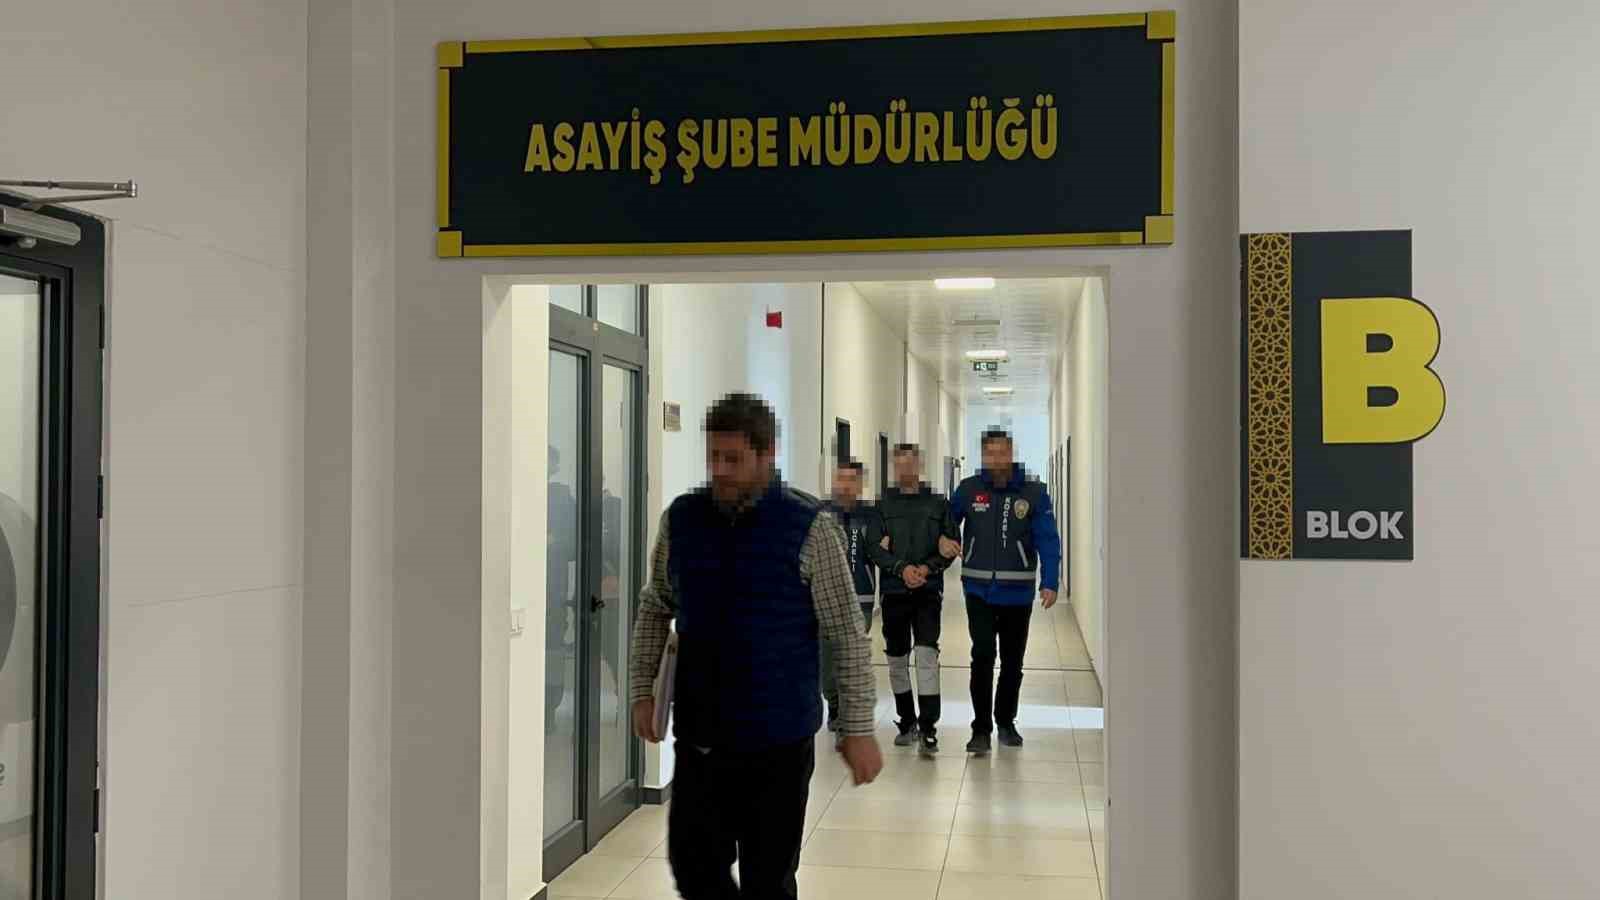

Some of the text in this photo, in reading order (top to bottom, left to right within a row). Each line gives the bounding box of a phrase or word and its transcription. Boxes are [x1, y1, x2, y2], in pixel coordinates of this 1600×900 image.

[524, 94, 1057, 184] ASAYİŞ ŞUBE MÜDÜRLÜĞÜ
[1320, 297, 1446, 444] B
[1306, 510, 1404, 540] BLOK
